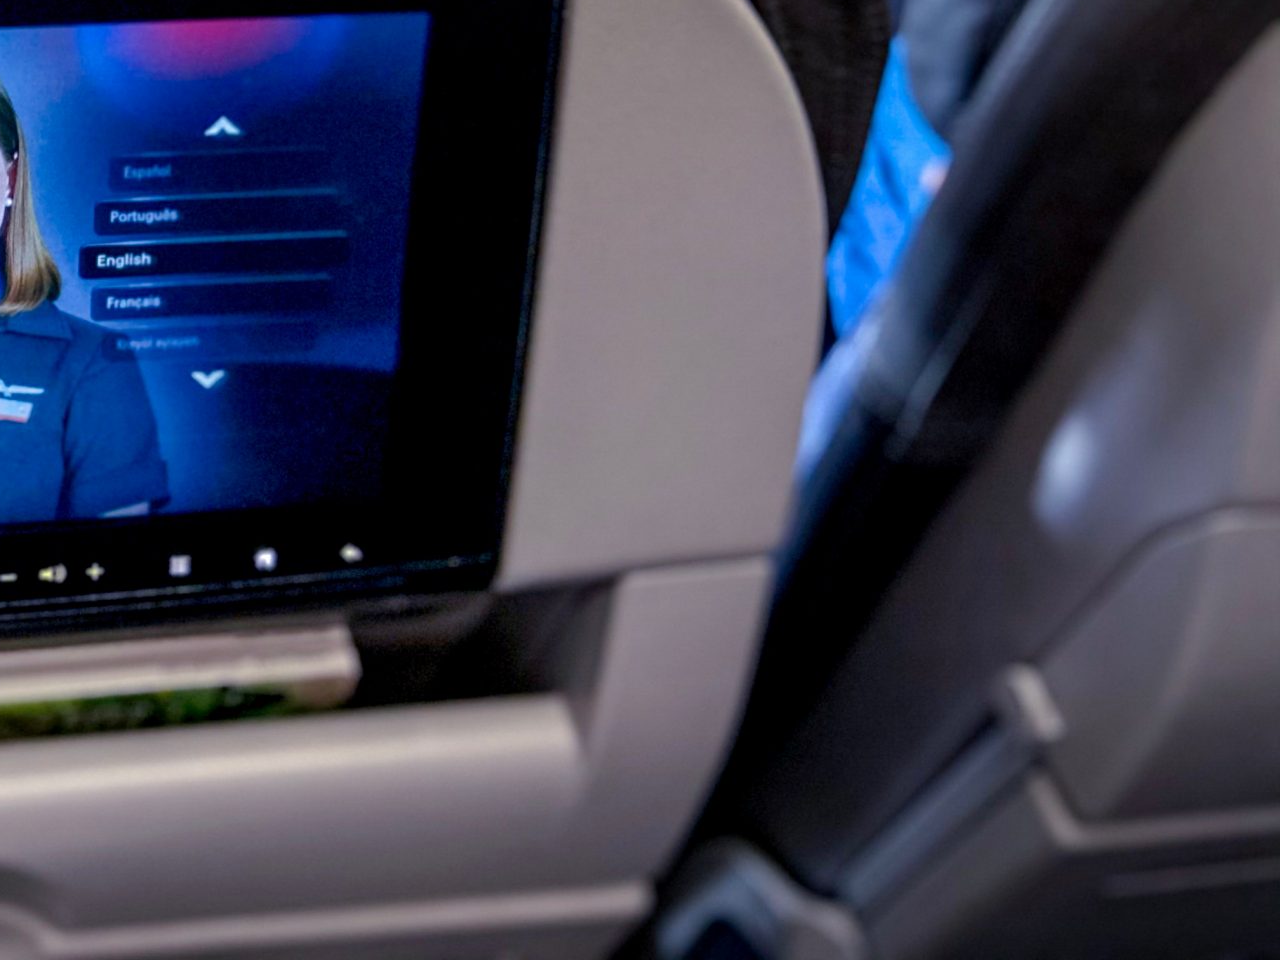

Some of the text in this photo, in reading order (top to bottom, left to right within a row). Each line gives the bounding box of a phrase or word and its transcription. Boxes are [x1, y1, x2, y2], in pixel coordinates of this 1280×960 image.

[110, 208, 178, 224] Português
[97, 252, 151, 268] English
[107, 295, 161, 310] Français
